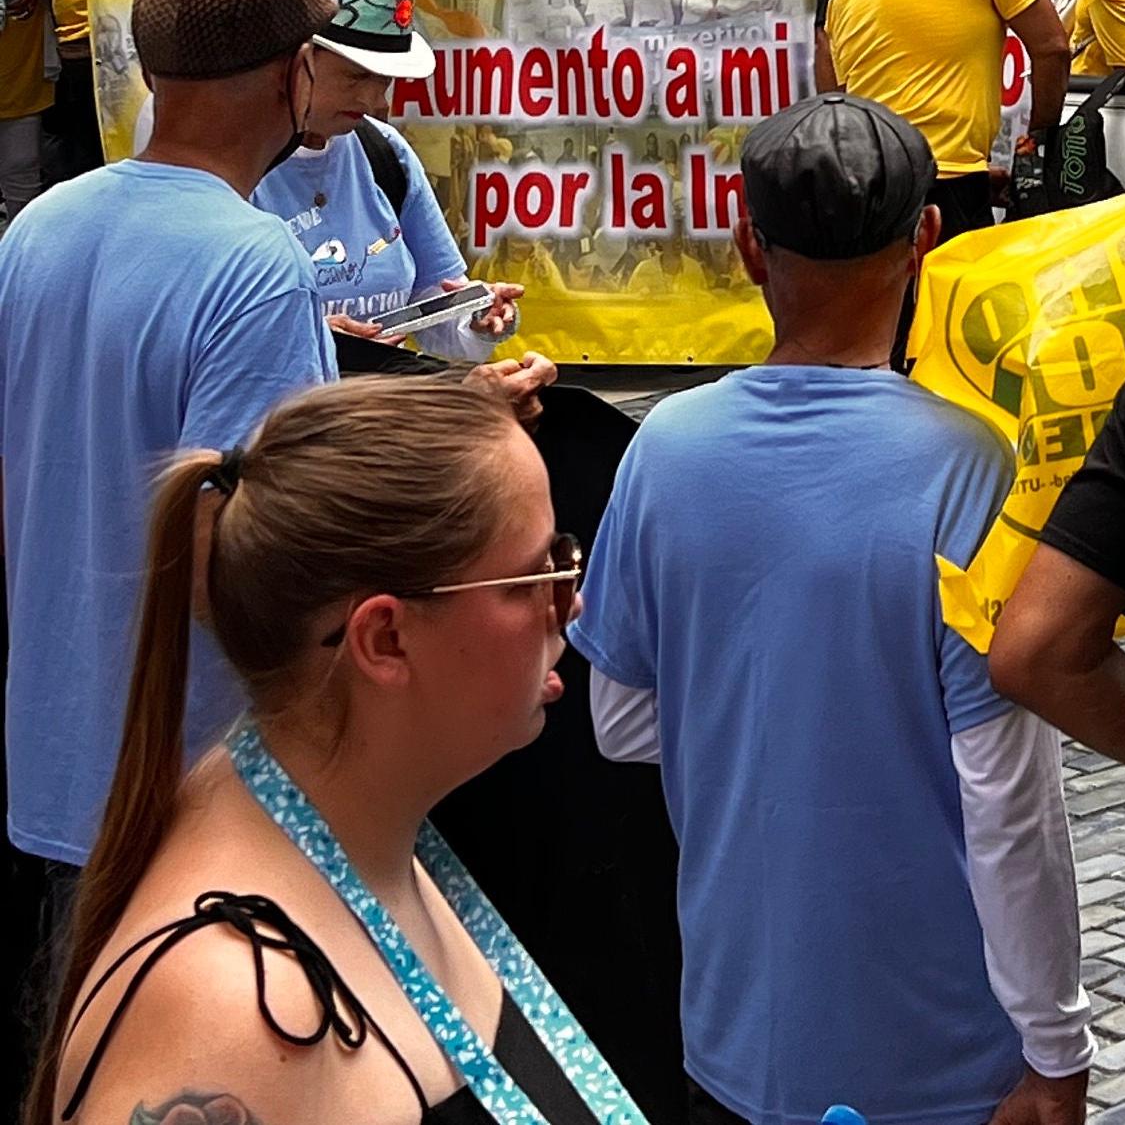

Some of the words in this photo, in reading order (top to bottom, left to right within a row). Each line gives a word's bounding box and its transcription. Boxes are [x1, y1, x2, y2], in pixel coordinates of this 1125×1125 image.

[393, 25, 643, 119] Aumento
[666, 47, 699, 118] a
[721, 23, 791, 118] mi
[474, 171, 590, 248] por
[610, 152, 667, 229] la
